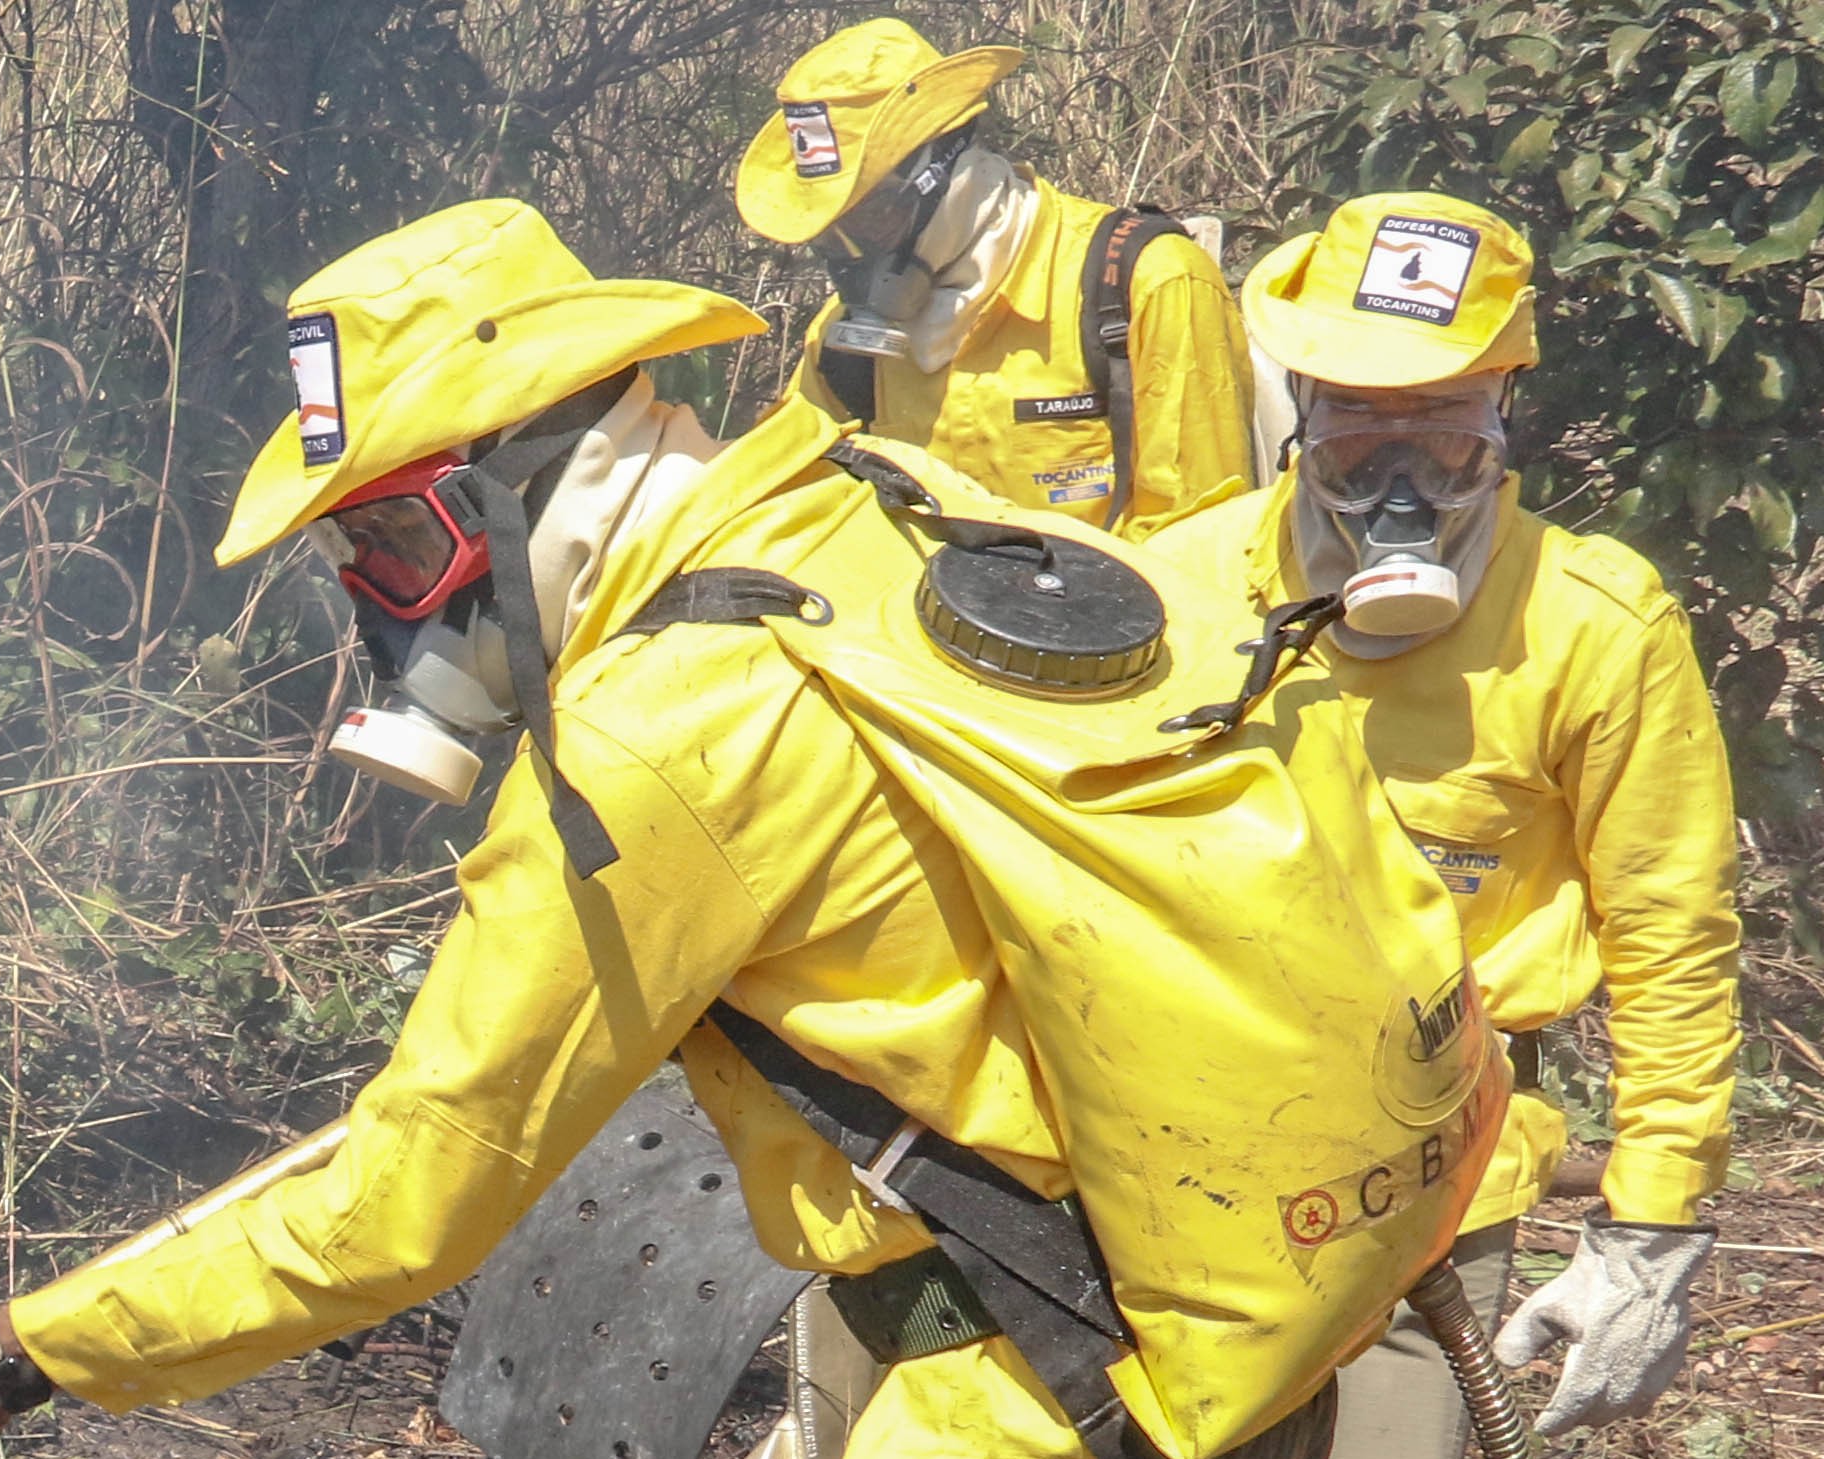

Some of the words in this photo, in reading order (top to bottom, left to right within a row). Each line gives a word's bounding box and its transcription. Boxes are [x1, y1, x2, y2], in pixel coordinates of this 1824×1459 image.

[1385, 219, 1436, 233] DEFESA
[1438, 226, 1471, 243] CIVIL
[1366, 296, 1441, 319] TOCANTINS
[1416, 844, 1501, 870] CANTINS
